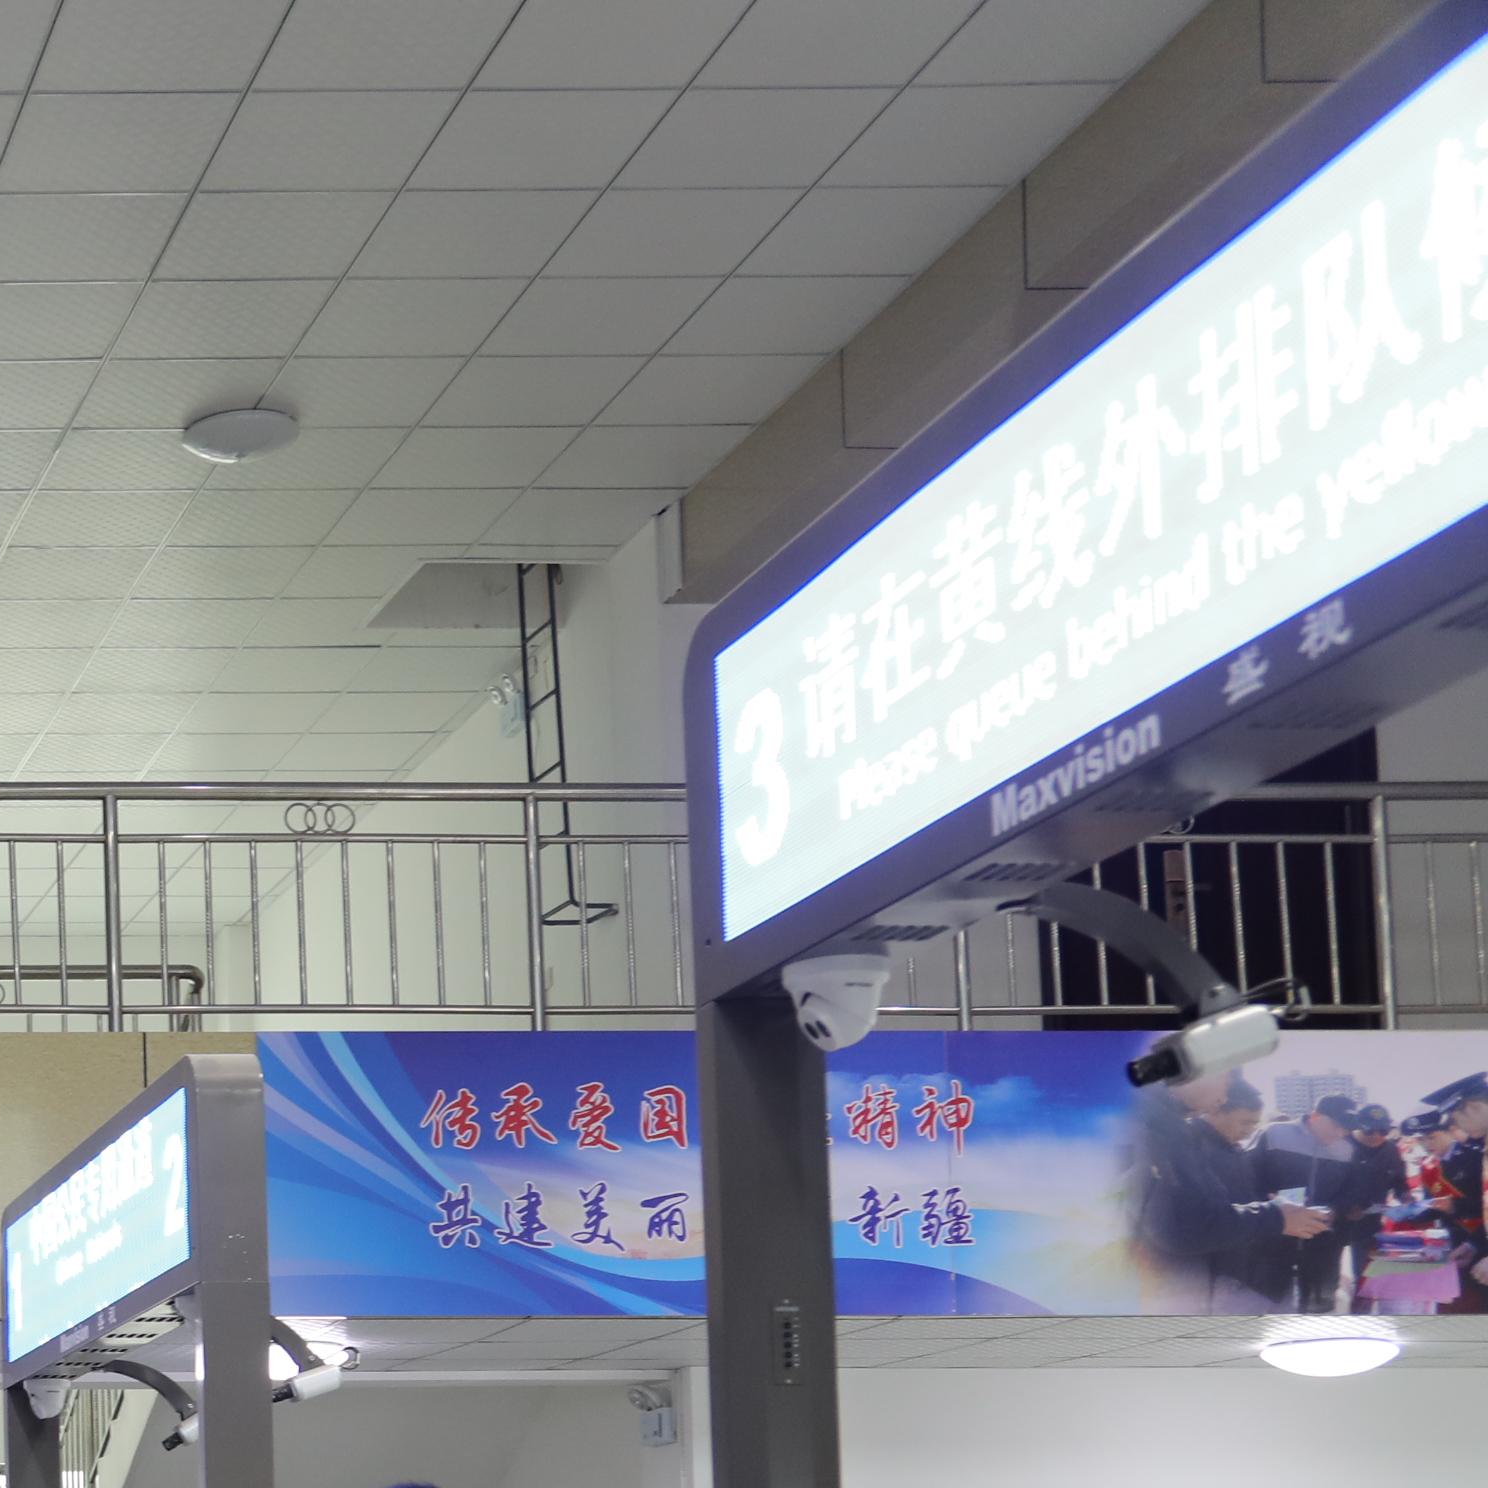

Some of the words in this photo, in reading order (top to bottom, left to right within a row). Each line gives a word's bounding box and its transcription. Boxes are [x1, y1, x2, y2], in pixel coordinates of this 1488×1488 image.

[837, 727, 938, 820] Please
[945, 651, 1057, 760] queue
[1066, 532, 1209, 678] behind
[1222, 493, 1304, 587] the
[734, 686, 791, 868] 3
[990, 711, 1163, 837] Maxvision
